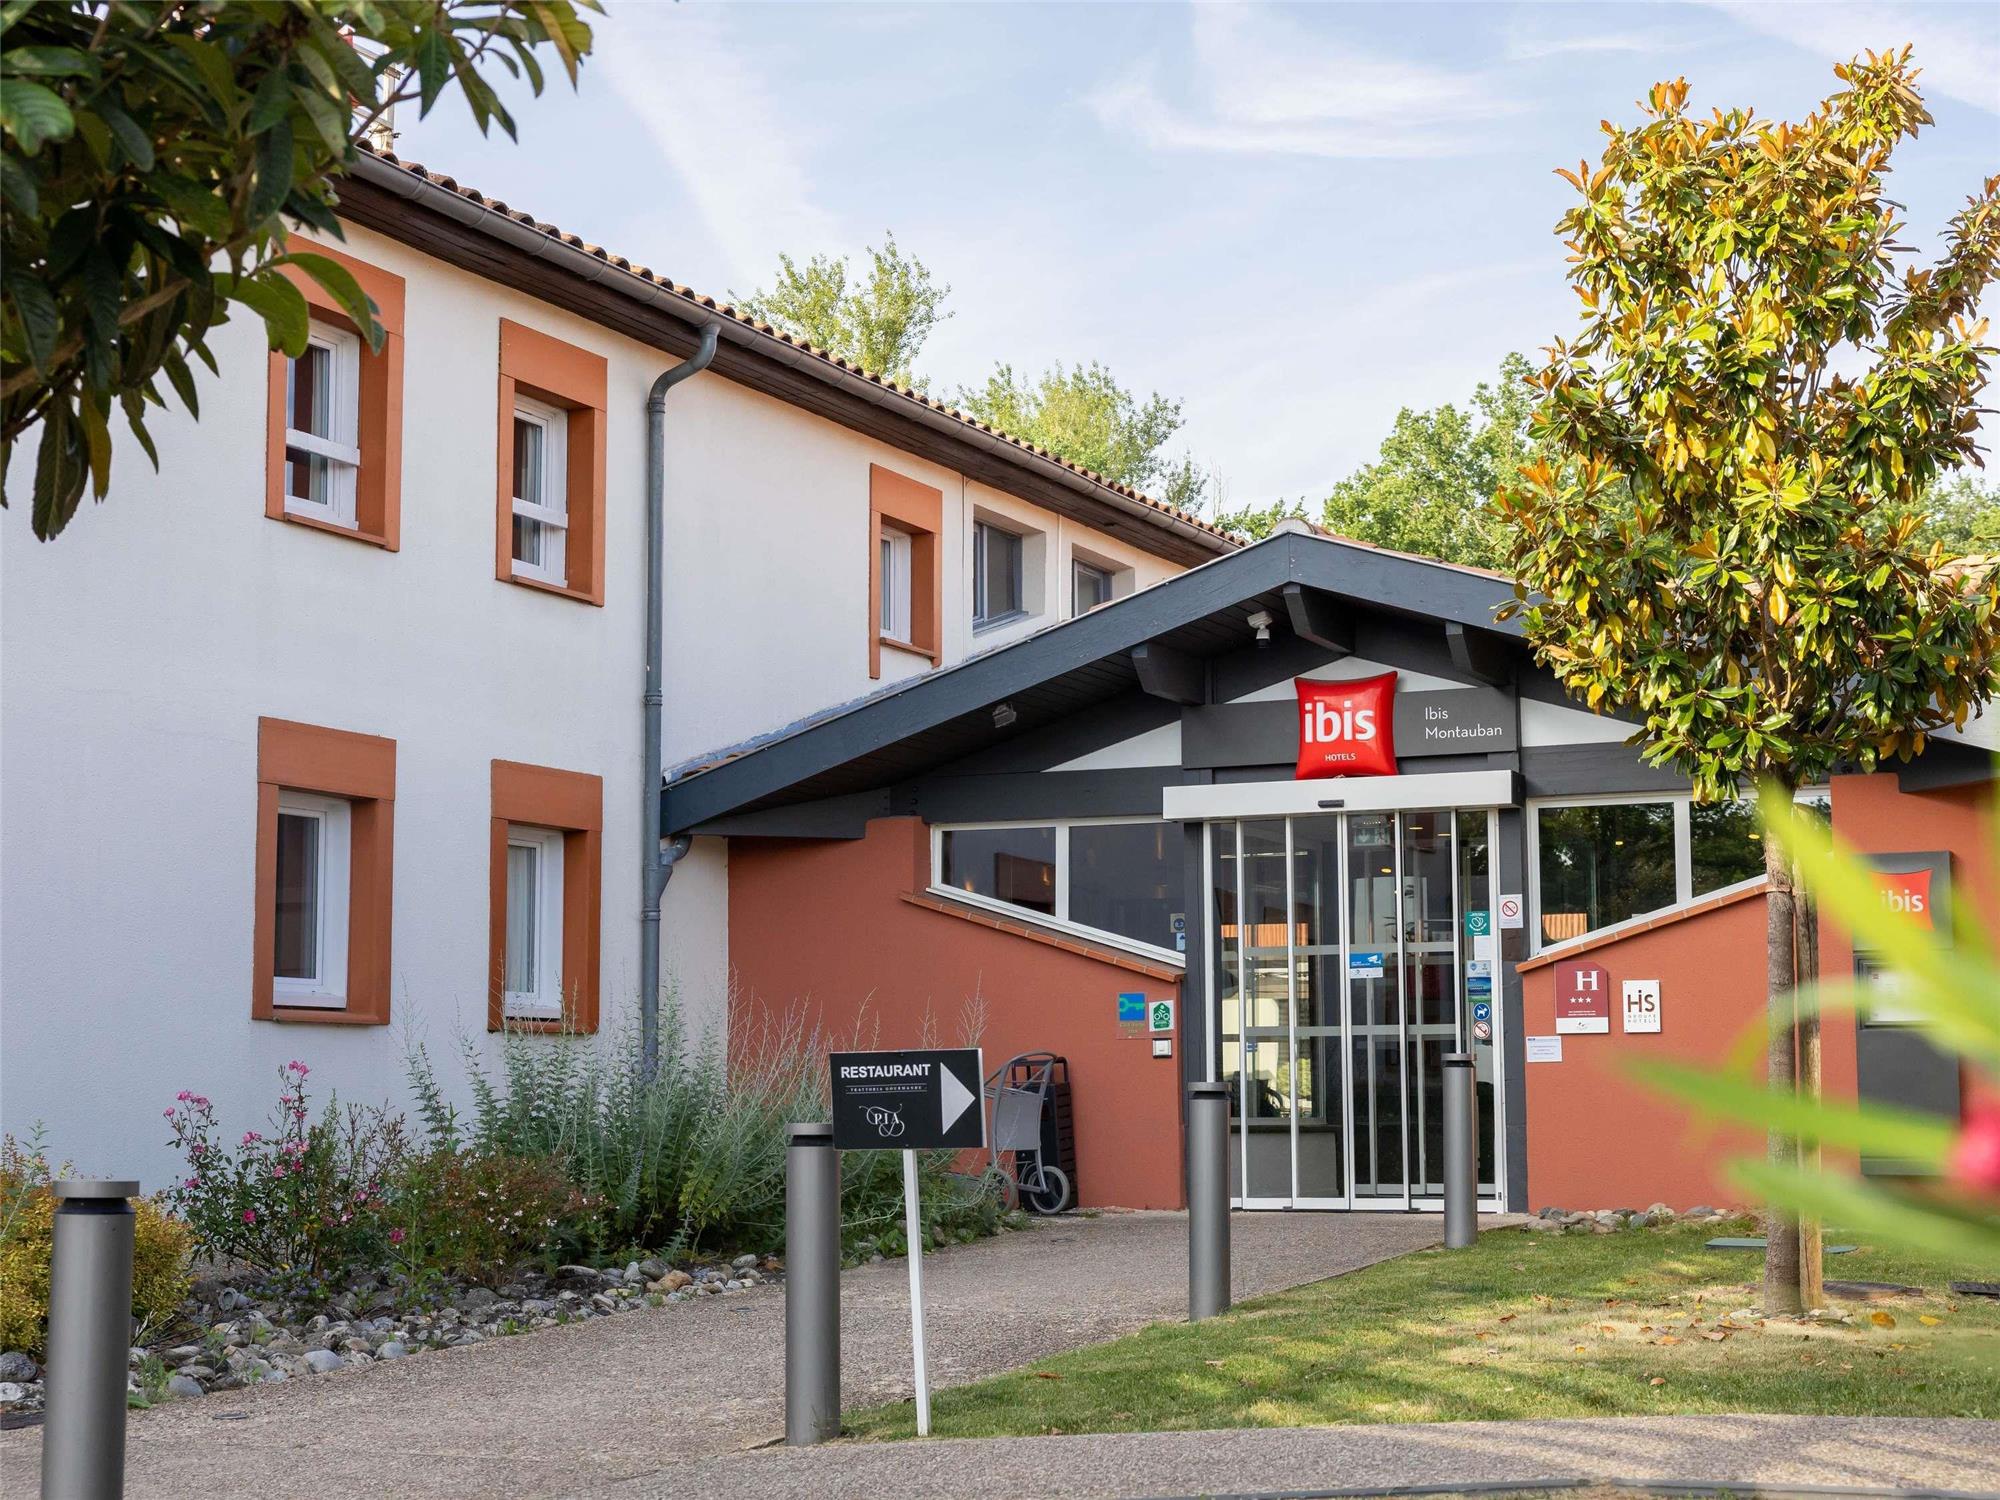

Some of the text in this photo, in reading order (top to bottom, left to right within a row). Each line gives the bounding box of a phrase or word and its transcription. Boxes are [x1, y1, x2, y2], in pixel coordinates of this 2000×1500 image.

[1305, 700, 1377, 743] ibis
[1425, 707, 1449, 721] Ibis
[1425, 723, 1503, 740] Montauban
[1325, 752, 1357, 762] HOTELS
[1881, 889, 1924, 912] ibis
[1576, 970, 1600, 991] H
[840, 1063, 931, 1079] RESTAURANT
